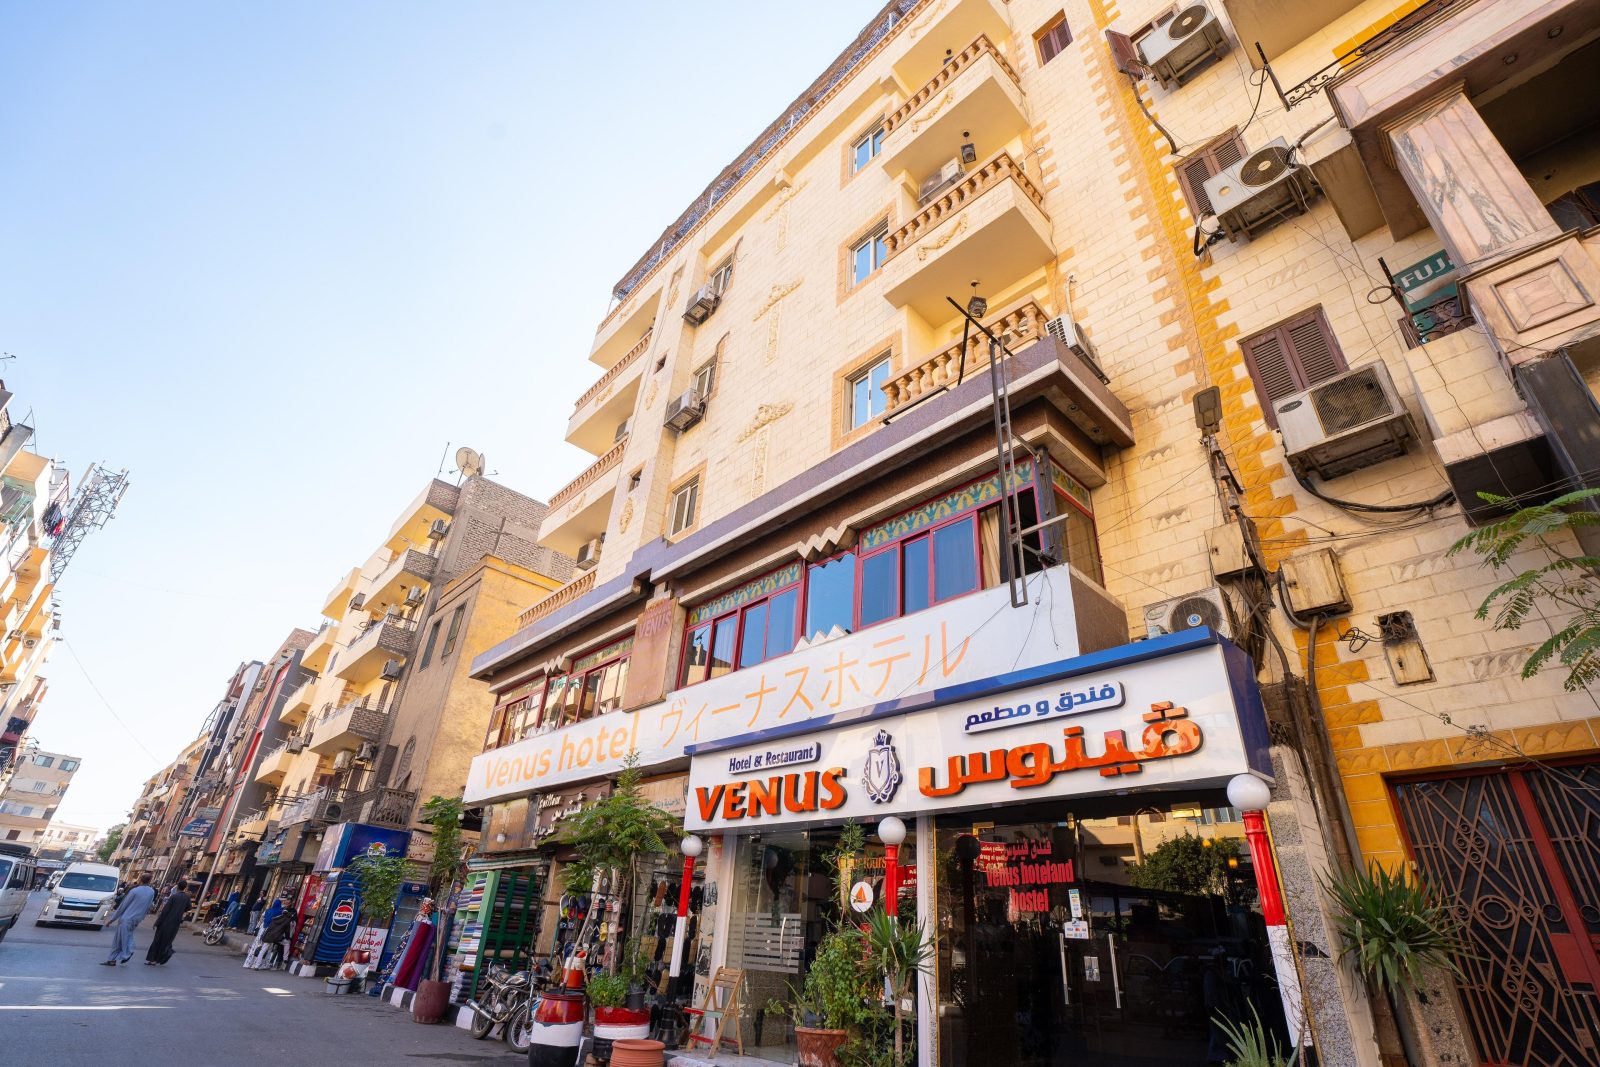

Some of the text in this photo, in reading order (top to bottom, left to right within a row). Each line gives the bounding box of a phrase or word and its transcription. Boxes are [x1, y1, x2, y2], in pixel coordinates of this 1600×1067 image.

[660, 620, 970, 749] ヴィーナスホテル
[965, 683, 1116, 731] فندق و مطعم
[485, 711, 640, 790] Venus hotel
[729, 746, 813, 771] Hotel & Restaurant
[695, 767, 848, 822] VENUS
